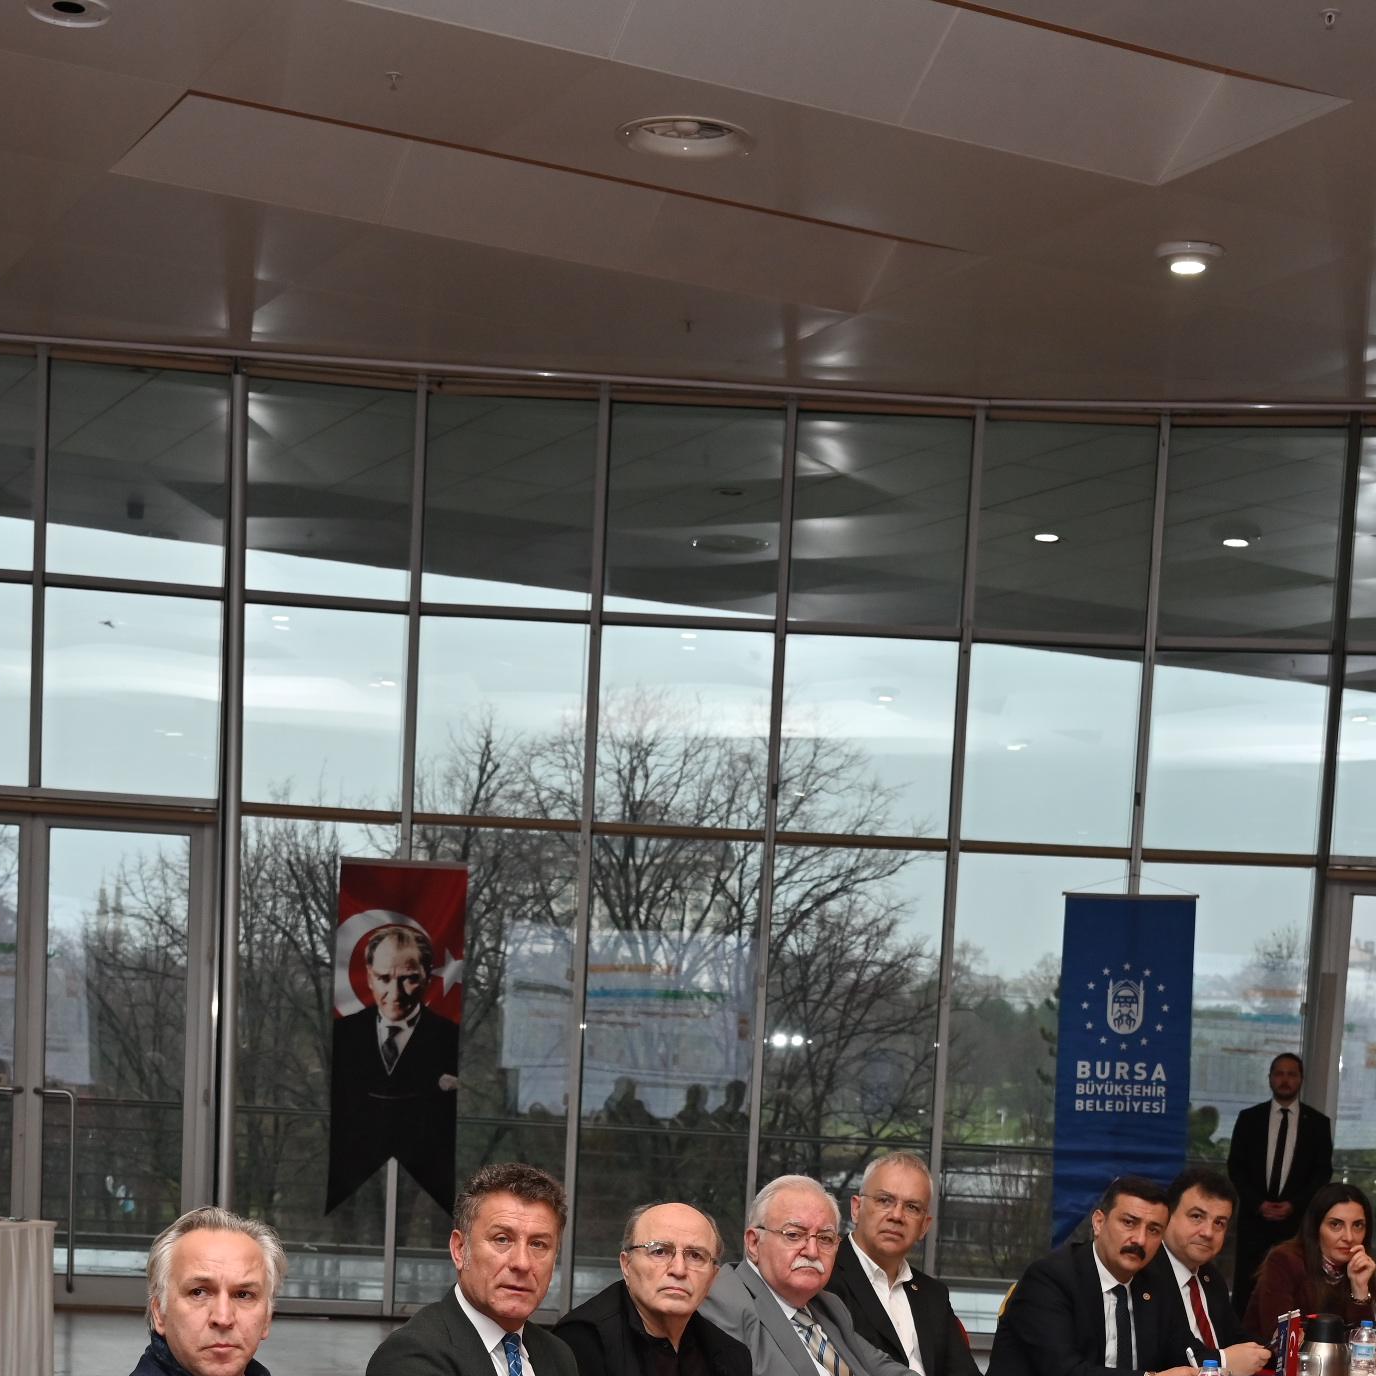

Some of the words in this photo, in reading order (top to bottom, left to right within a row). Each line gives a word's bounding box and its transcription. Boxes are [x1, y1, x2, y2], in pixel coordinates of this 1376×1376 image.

[1076, 1060, 1168, 1082] BURSA
[1075, 1080, 1166, 1099] BÜYÜKŞEHİR
[1074, 1096, 1167, 1114] BELEDİYESİ
